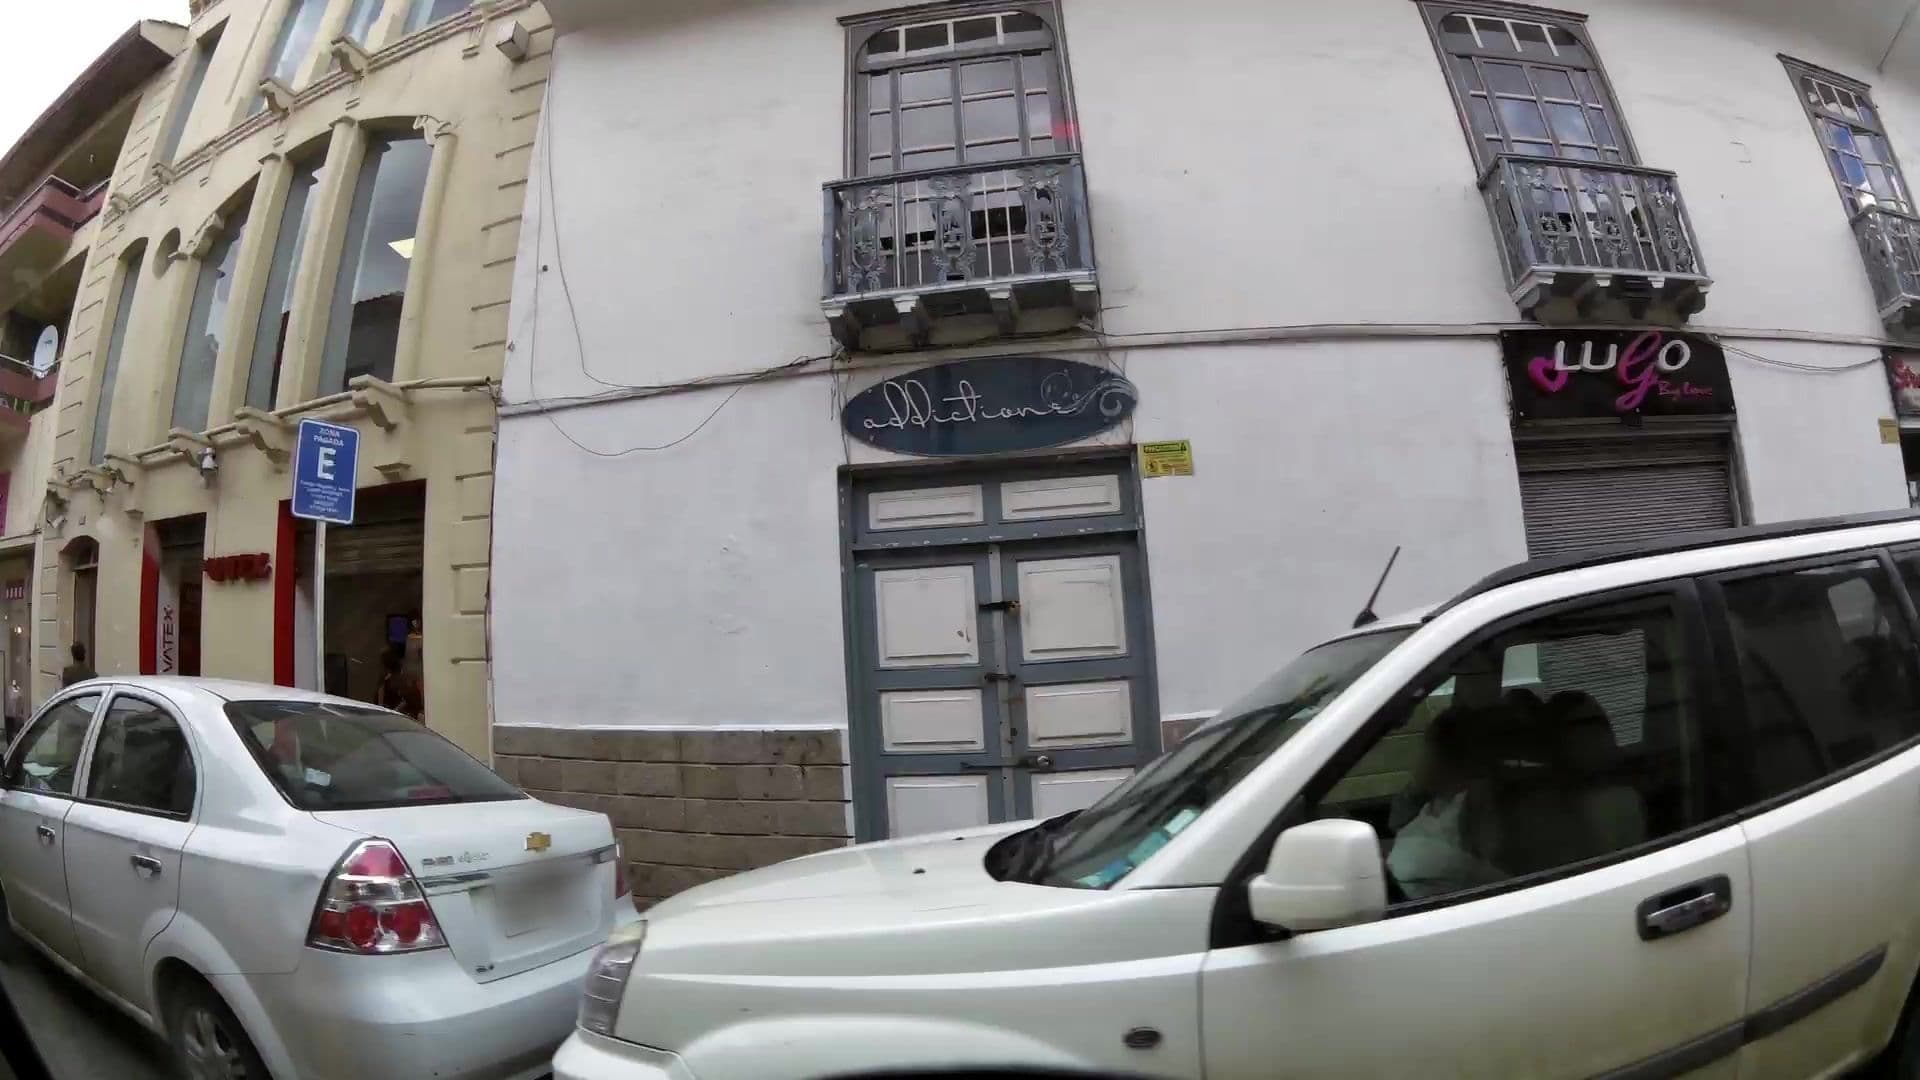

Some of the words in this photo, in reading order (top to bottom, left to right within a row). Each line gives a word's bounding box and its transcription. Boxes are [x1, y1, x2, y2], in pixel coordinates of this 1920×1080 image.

[319, 427, 341, 438] ZONA
[313, 434, 345, 447] PAGADA
[317, 446, 337, 480] E
